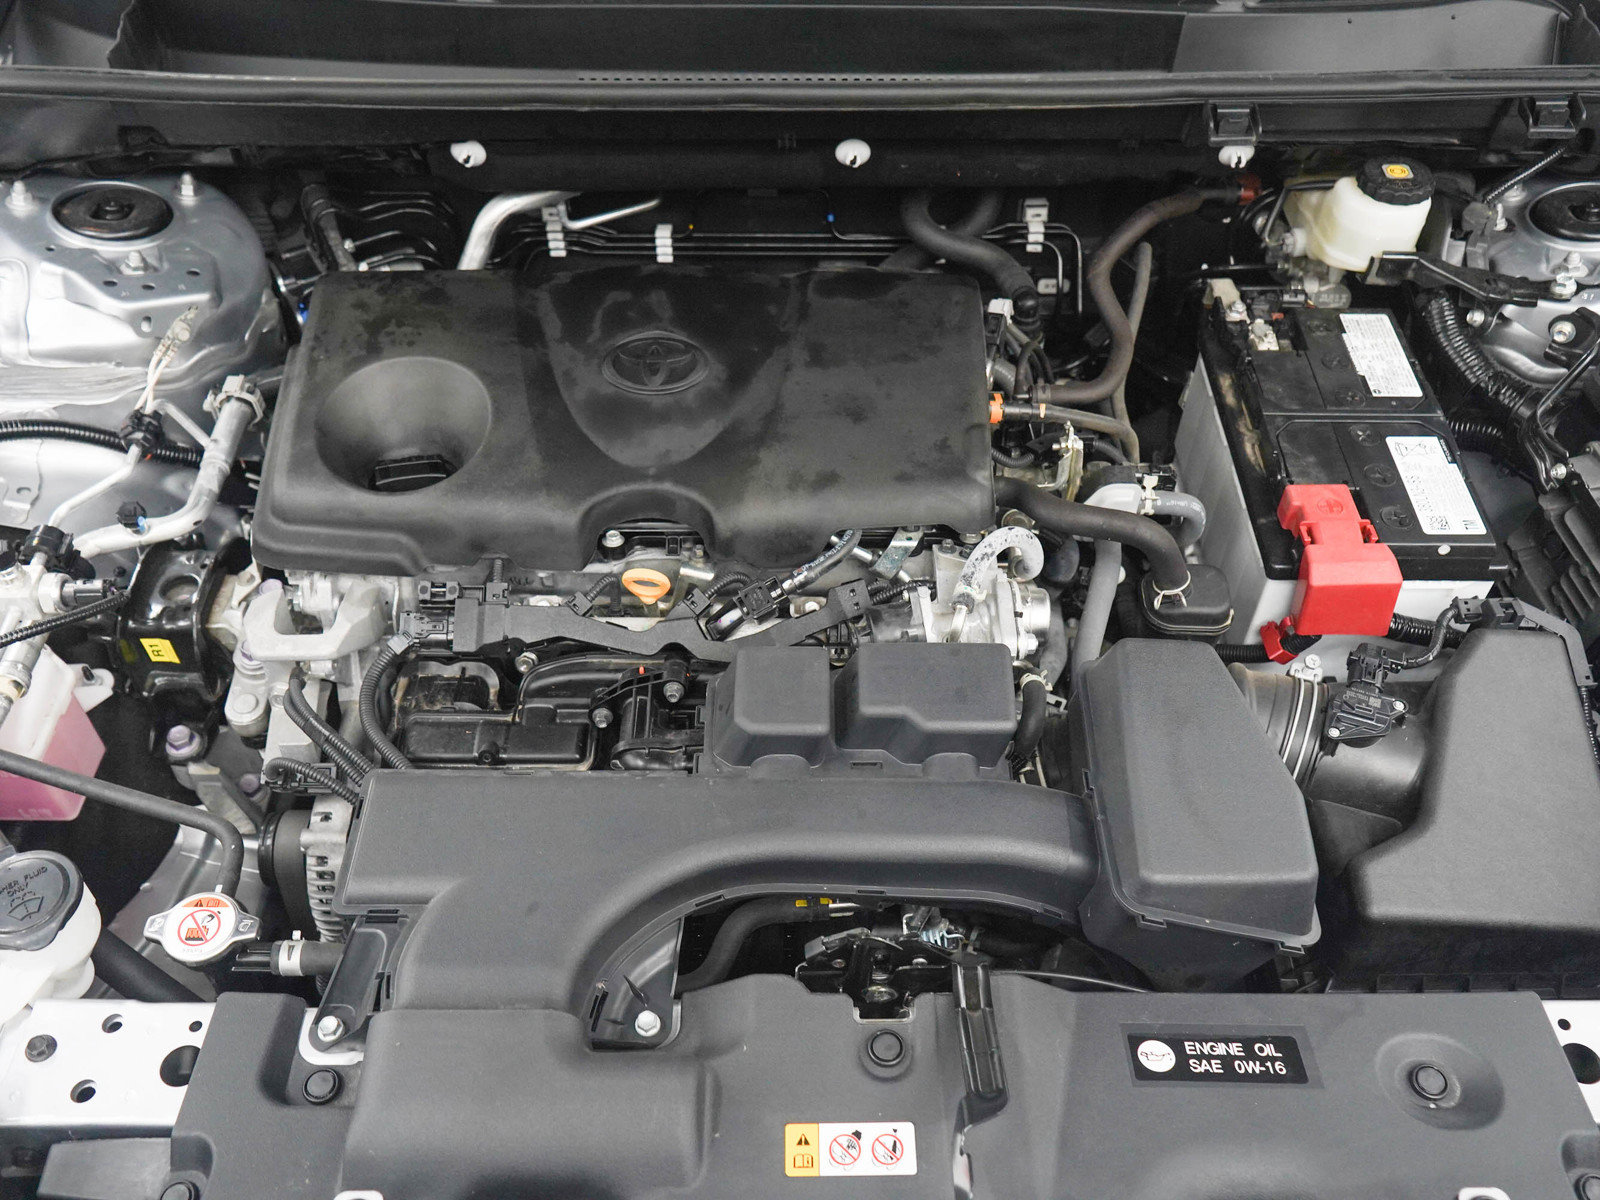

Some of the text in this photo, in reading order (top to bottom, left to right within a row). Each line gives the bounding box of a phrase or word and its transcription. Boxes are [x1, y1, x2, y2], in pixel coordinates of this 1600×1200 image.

[148, 644, 165, 657] R1
[24, 866, 48, 882] FLUID
[7, 881, 29, 897] ONLY
[1183, 1041, 1283, 1057] ENGINE OIL
[1189, 1059, 1287, 1075] SAE 0W-16
